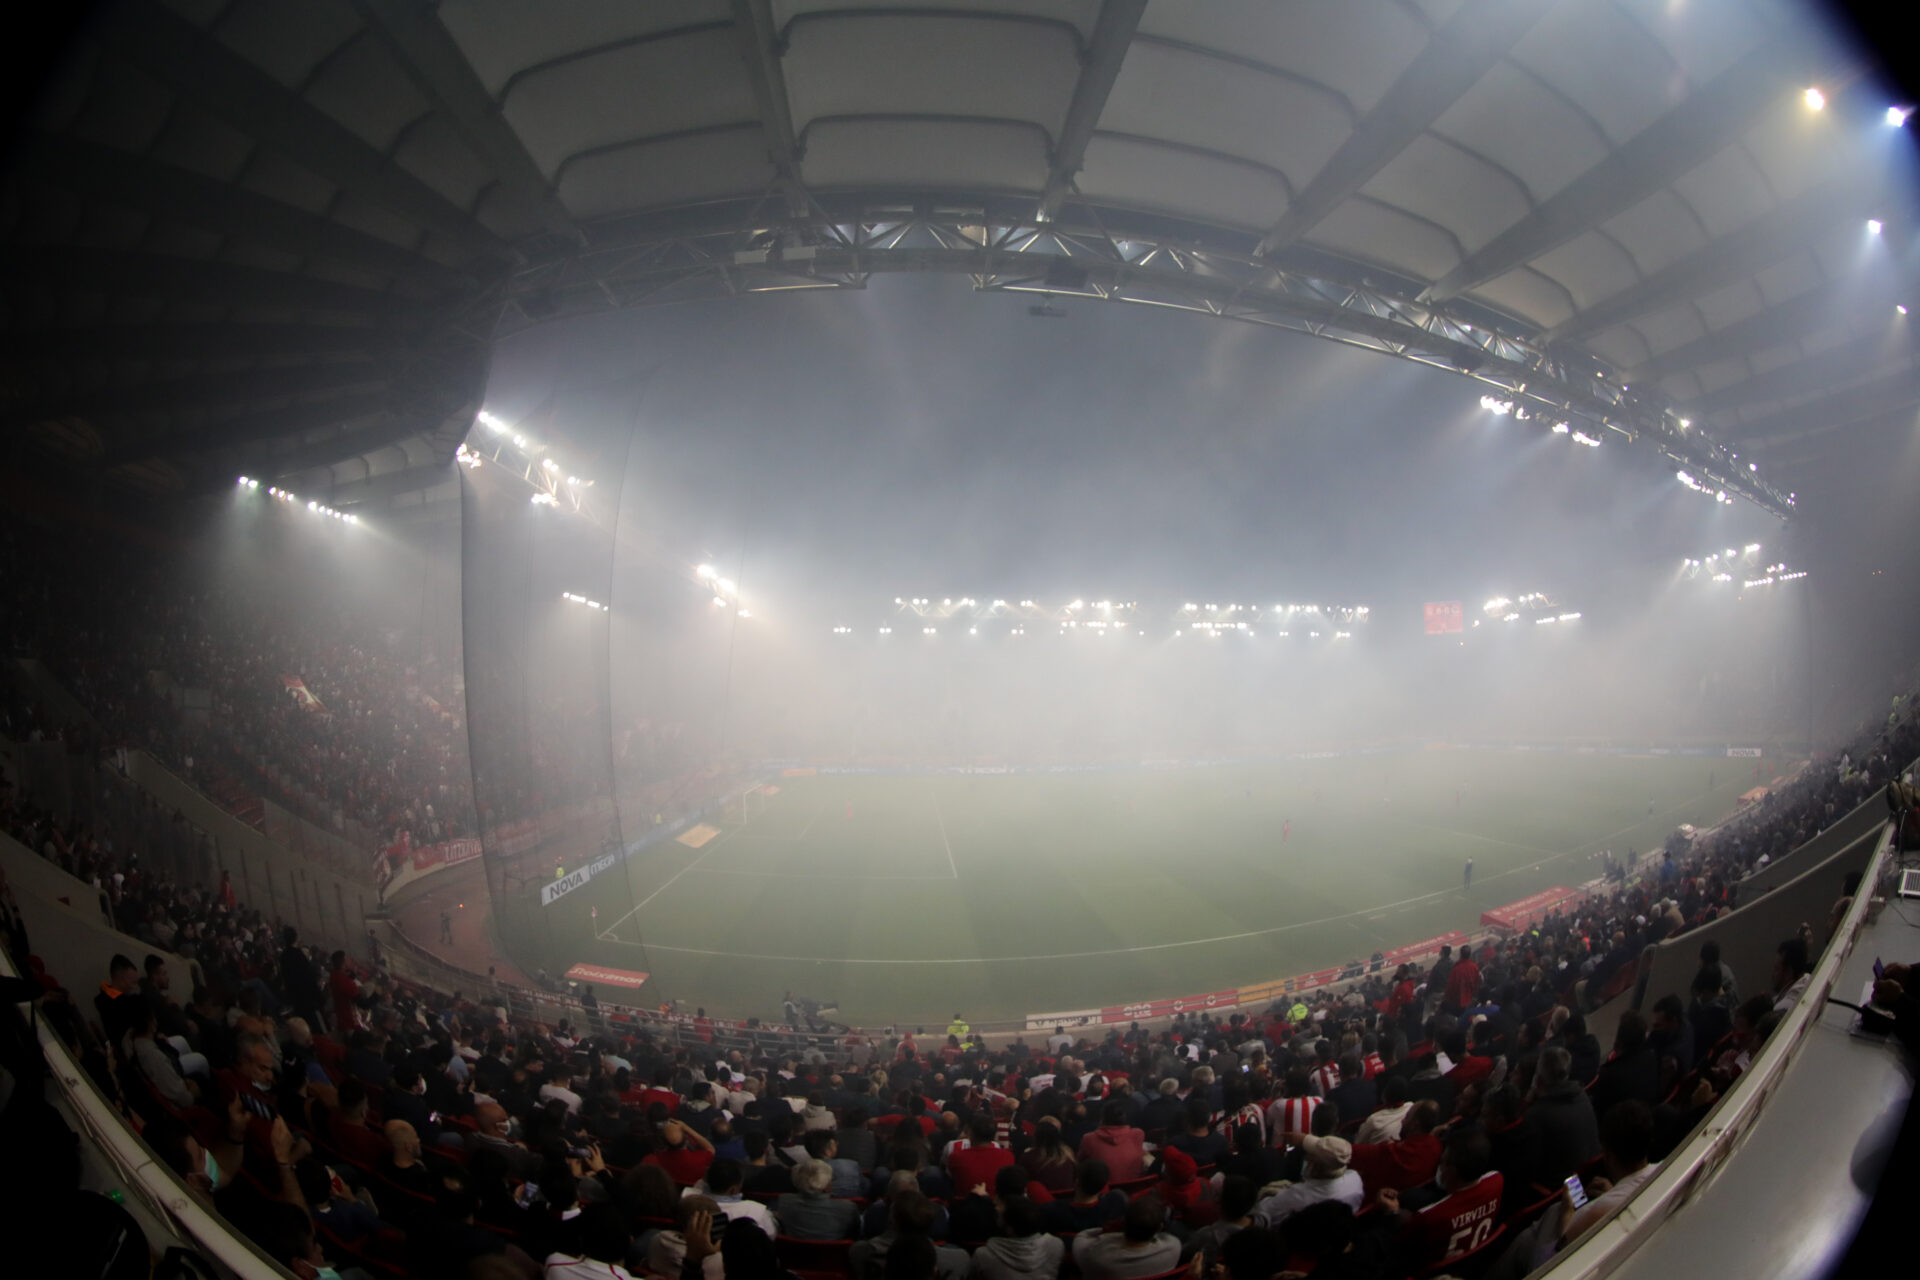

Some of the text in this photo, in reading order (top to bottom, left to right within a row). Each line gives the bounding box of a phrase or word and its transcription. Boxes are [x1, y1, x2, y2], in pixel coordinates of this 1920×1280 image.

[550, 872, 583, 899] NOVA
[568, 967, 645, 984] Stoiximan
[1451, 1198, 1498, 1230] VIRVILIS
